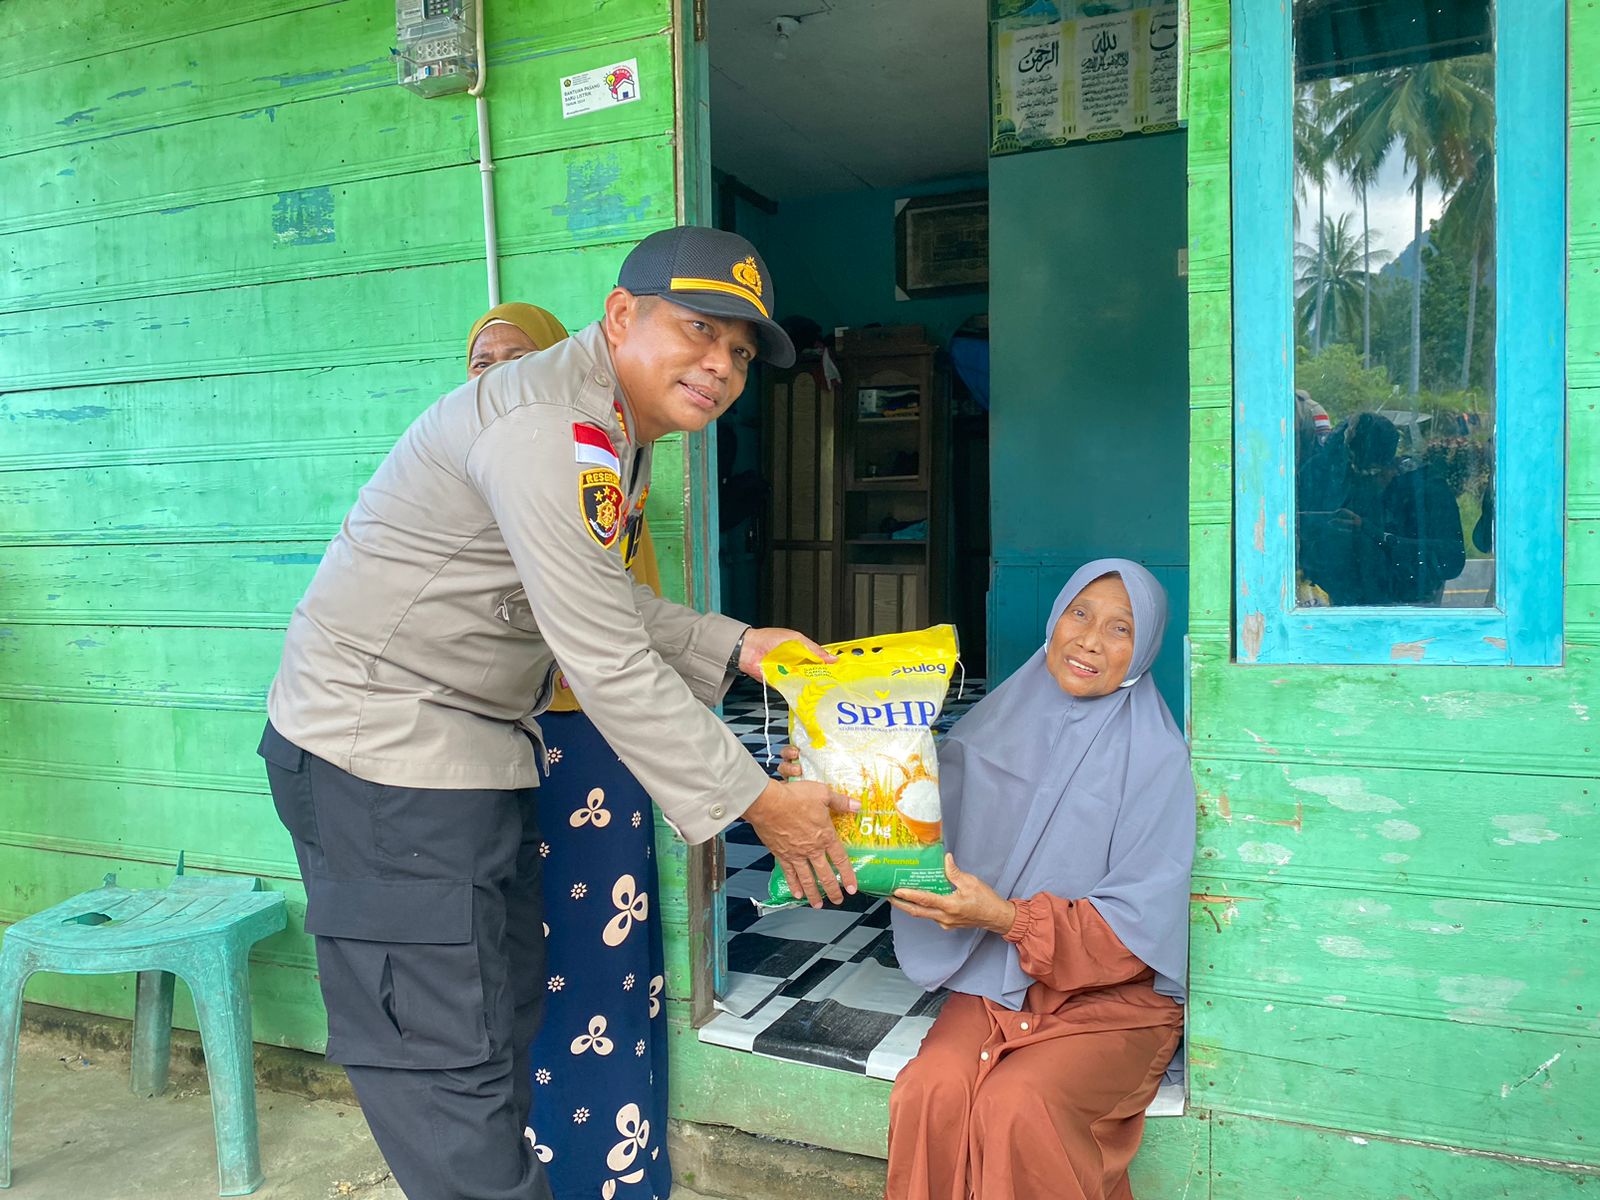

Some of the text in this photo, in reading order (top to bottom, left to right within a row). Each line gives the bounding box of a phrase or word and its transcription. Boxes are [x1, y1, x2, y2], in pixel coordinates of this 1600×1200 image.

[564, 83, 600, 96] BANTUAN PASANG
[577, 91, 591, 99] LISTRIK
[902, 663, 946, 675] bulog
[837, 701, 936, 727] SPHP
